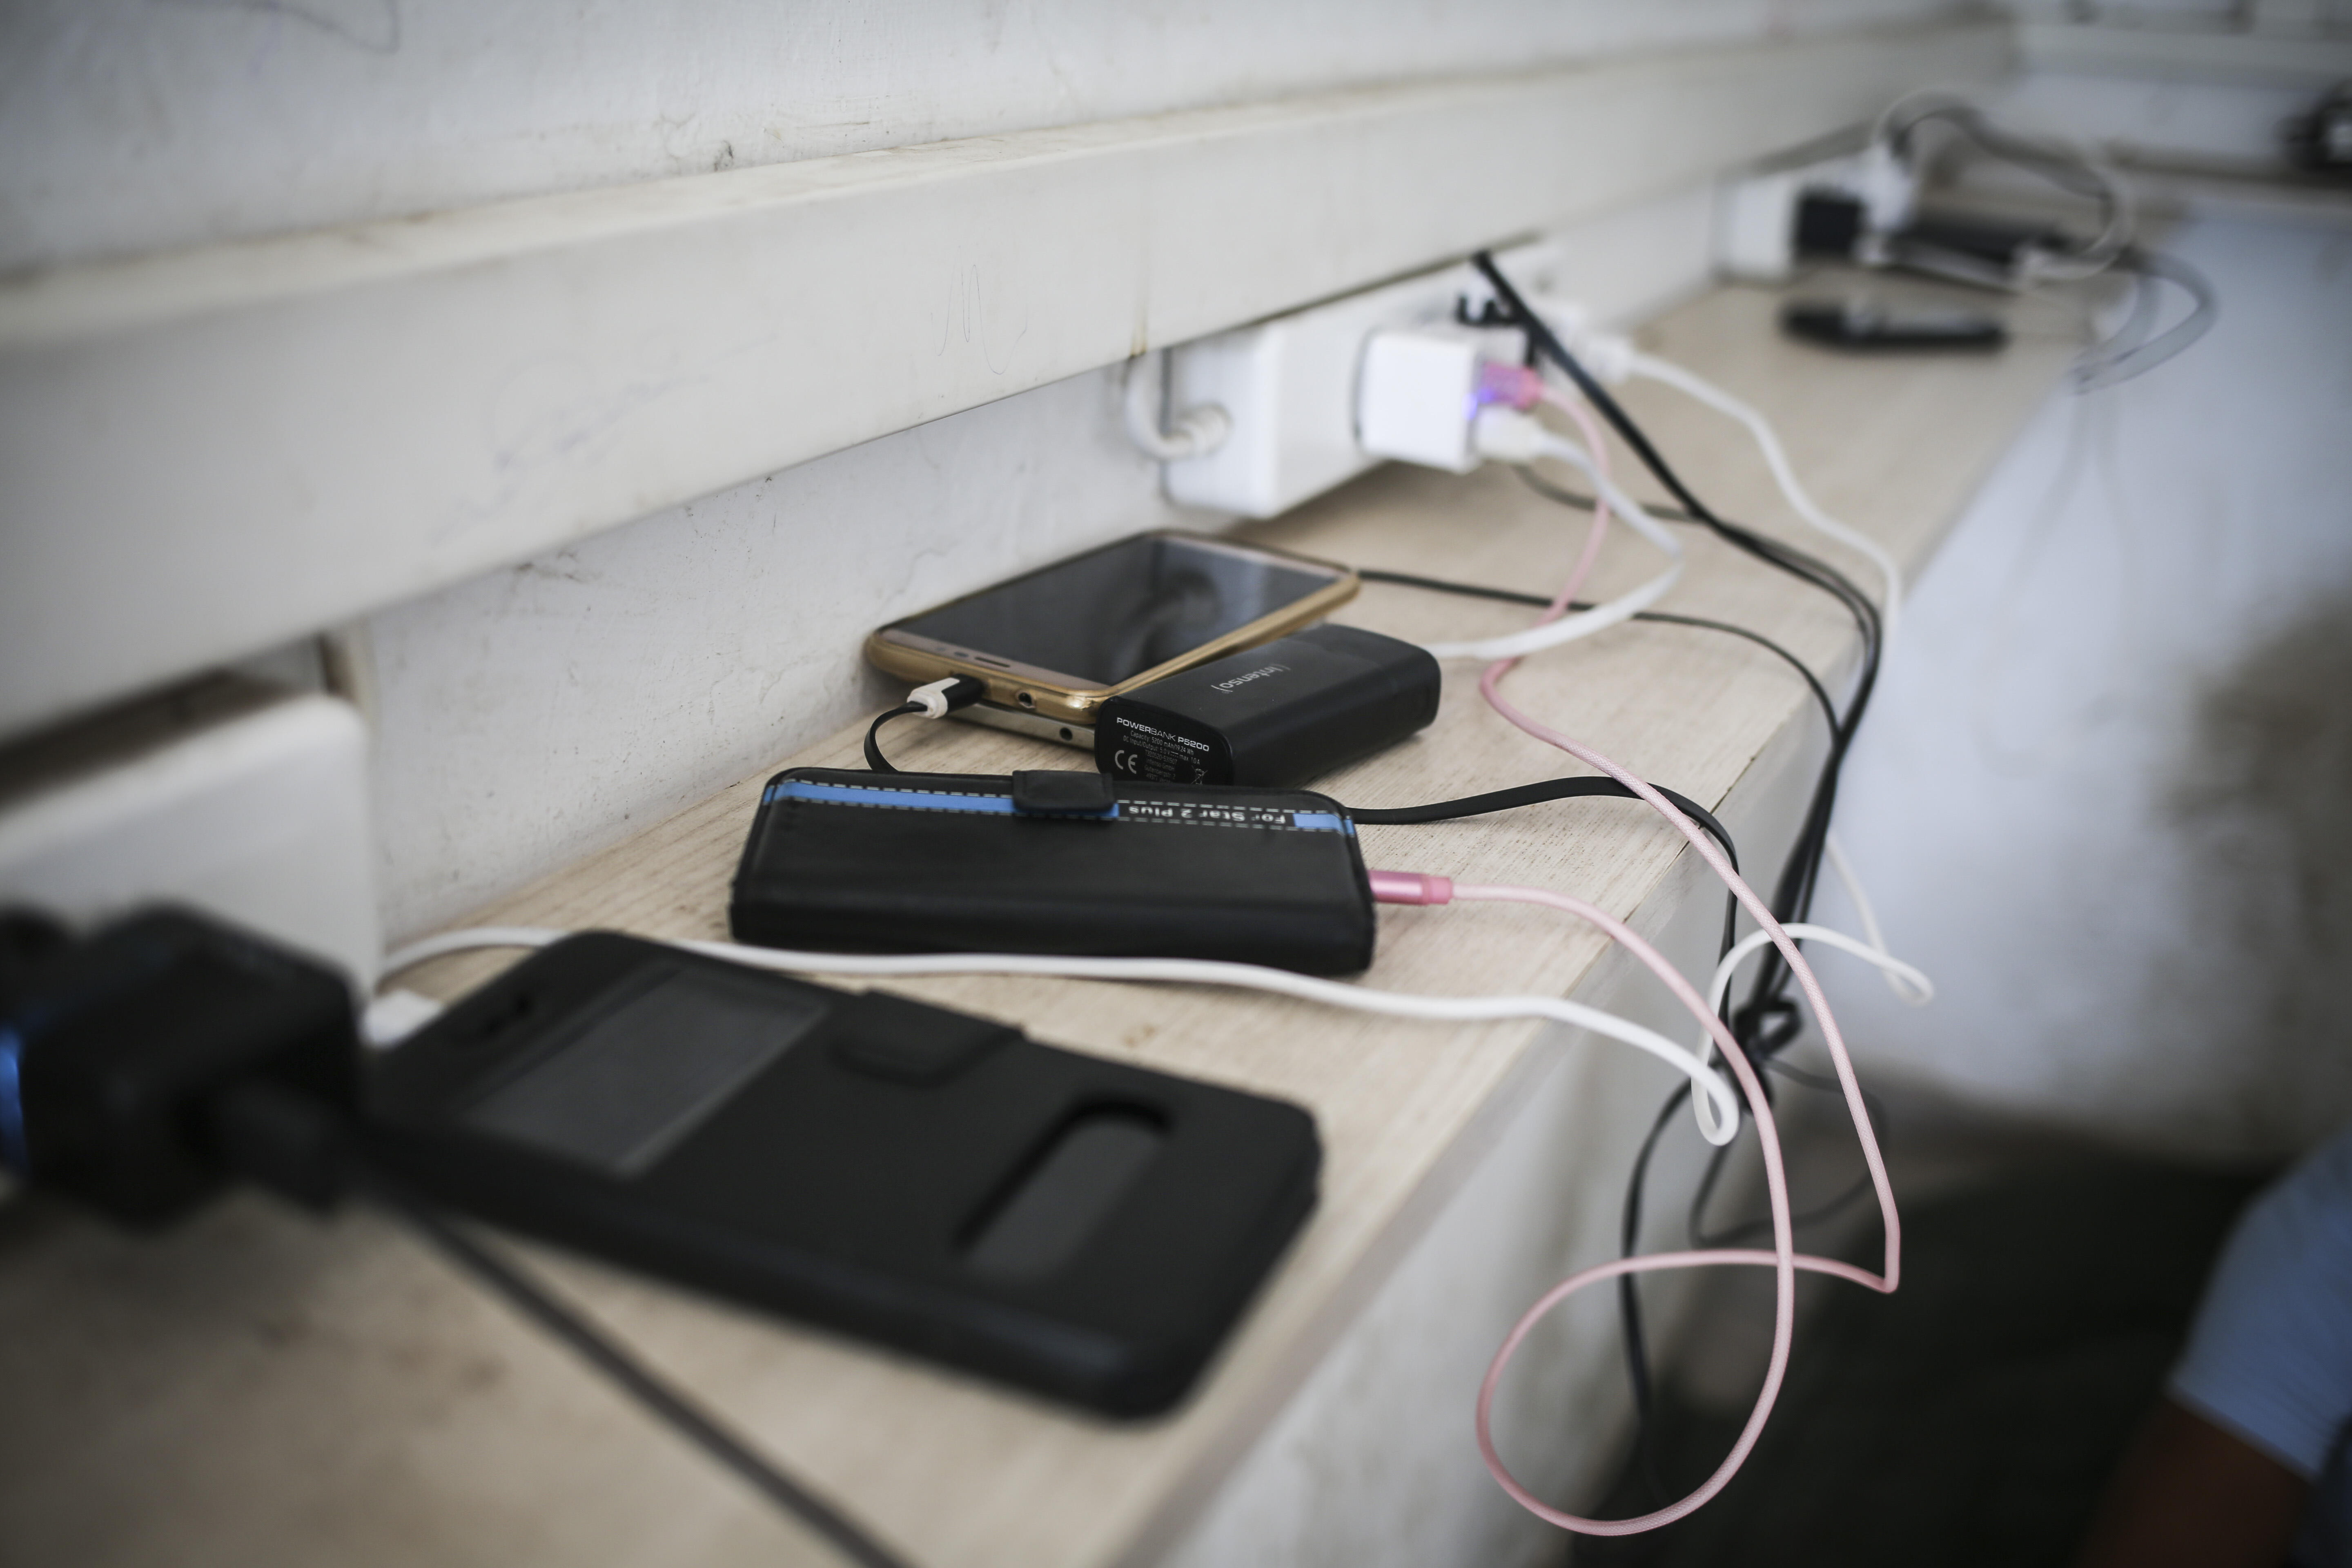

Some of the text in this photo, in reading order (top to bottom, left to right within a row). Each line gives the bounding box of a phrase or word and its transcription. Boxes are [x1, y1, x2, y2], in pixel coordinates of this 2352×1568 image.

[1117, 717, 1209, 752] POWERBANK P5200
[1152, 737, 1163, 746] 5200
[1180, 808, 1192, 818] 2
[1198, 810, 1245, 822] Star
[1250, 814, 1285, 824] For
